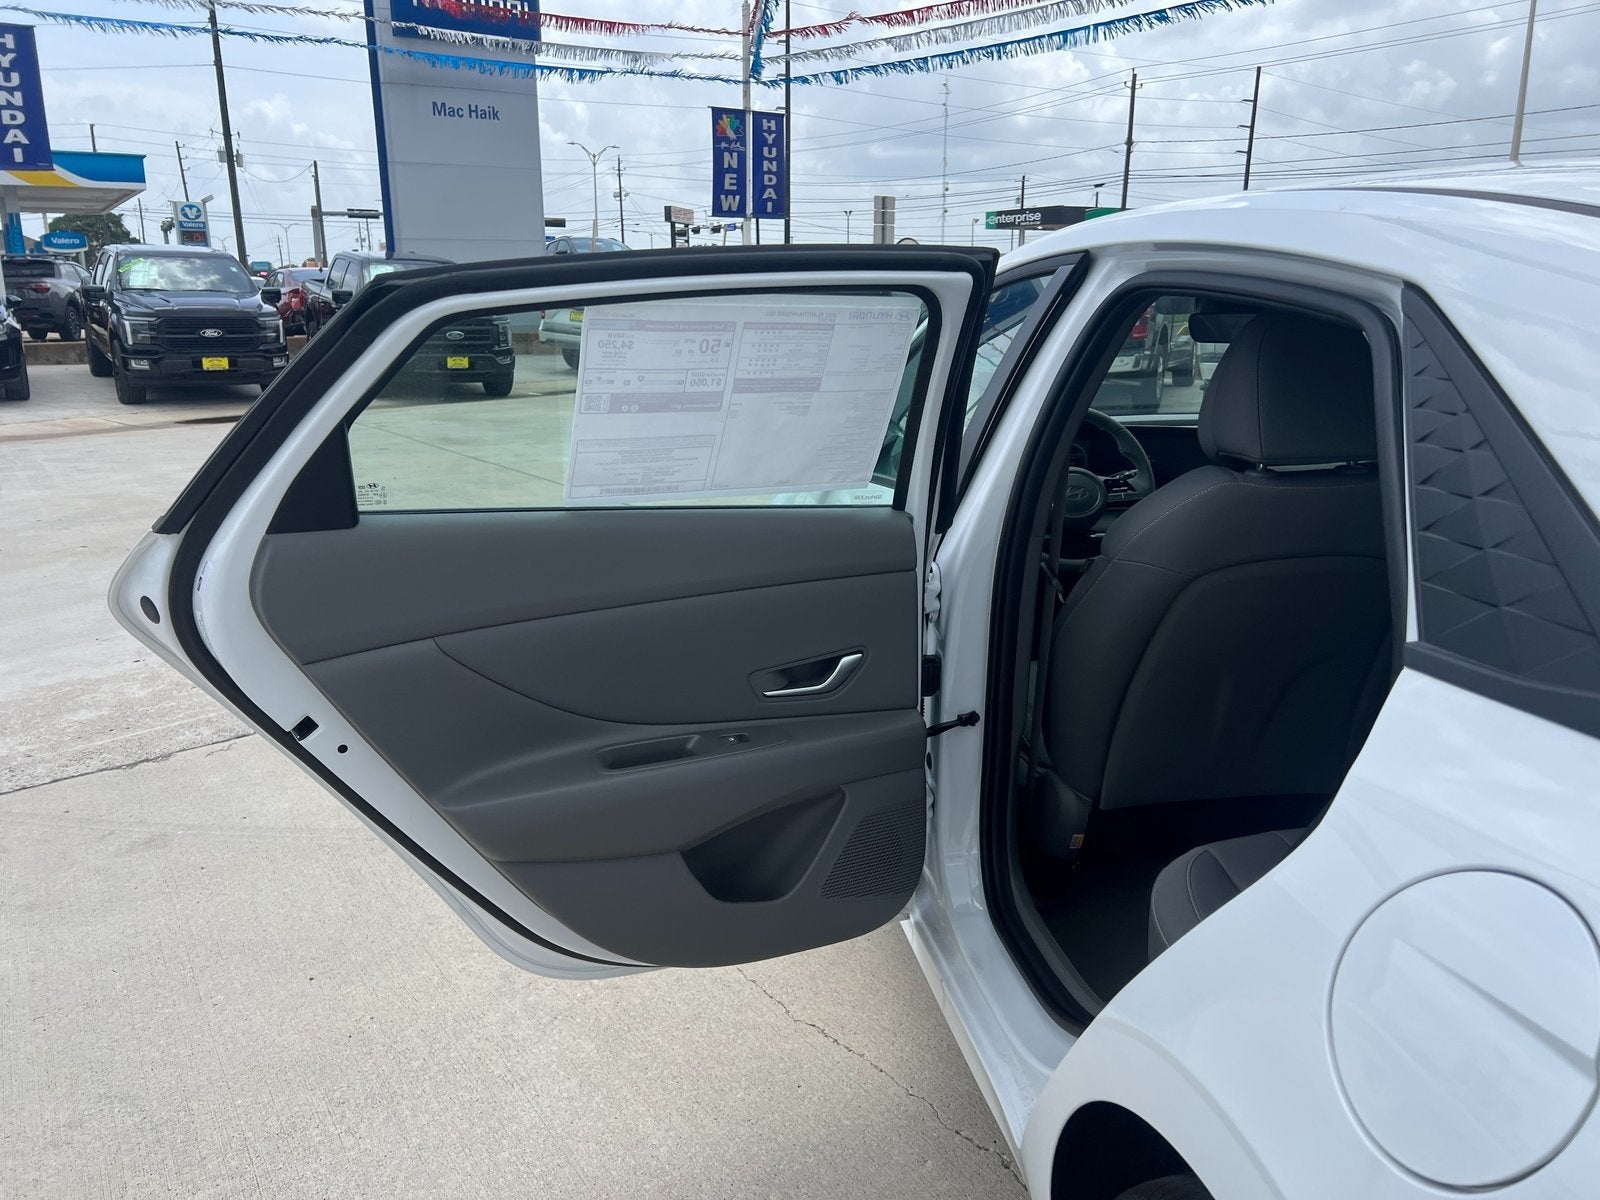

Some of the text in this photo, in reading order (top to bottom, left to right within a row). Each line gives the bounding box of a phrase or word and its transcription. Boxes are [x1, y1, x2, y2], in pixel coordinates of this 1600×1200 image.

[432, 101, 501, 121] Mac Haik
[762, 118, 778, 213] HYUNDAI
[720, 151, 741, 212] NEW
[987, 210, 1042, 226] enterprise
[50, 236, 80, 244] Valero
